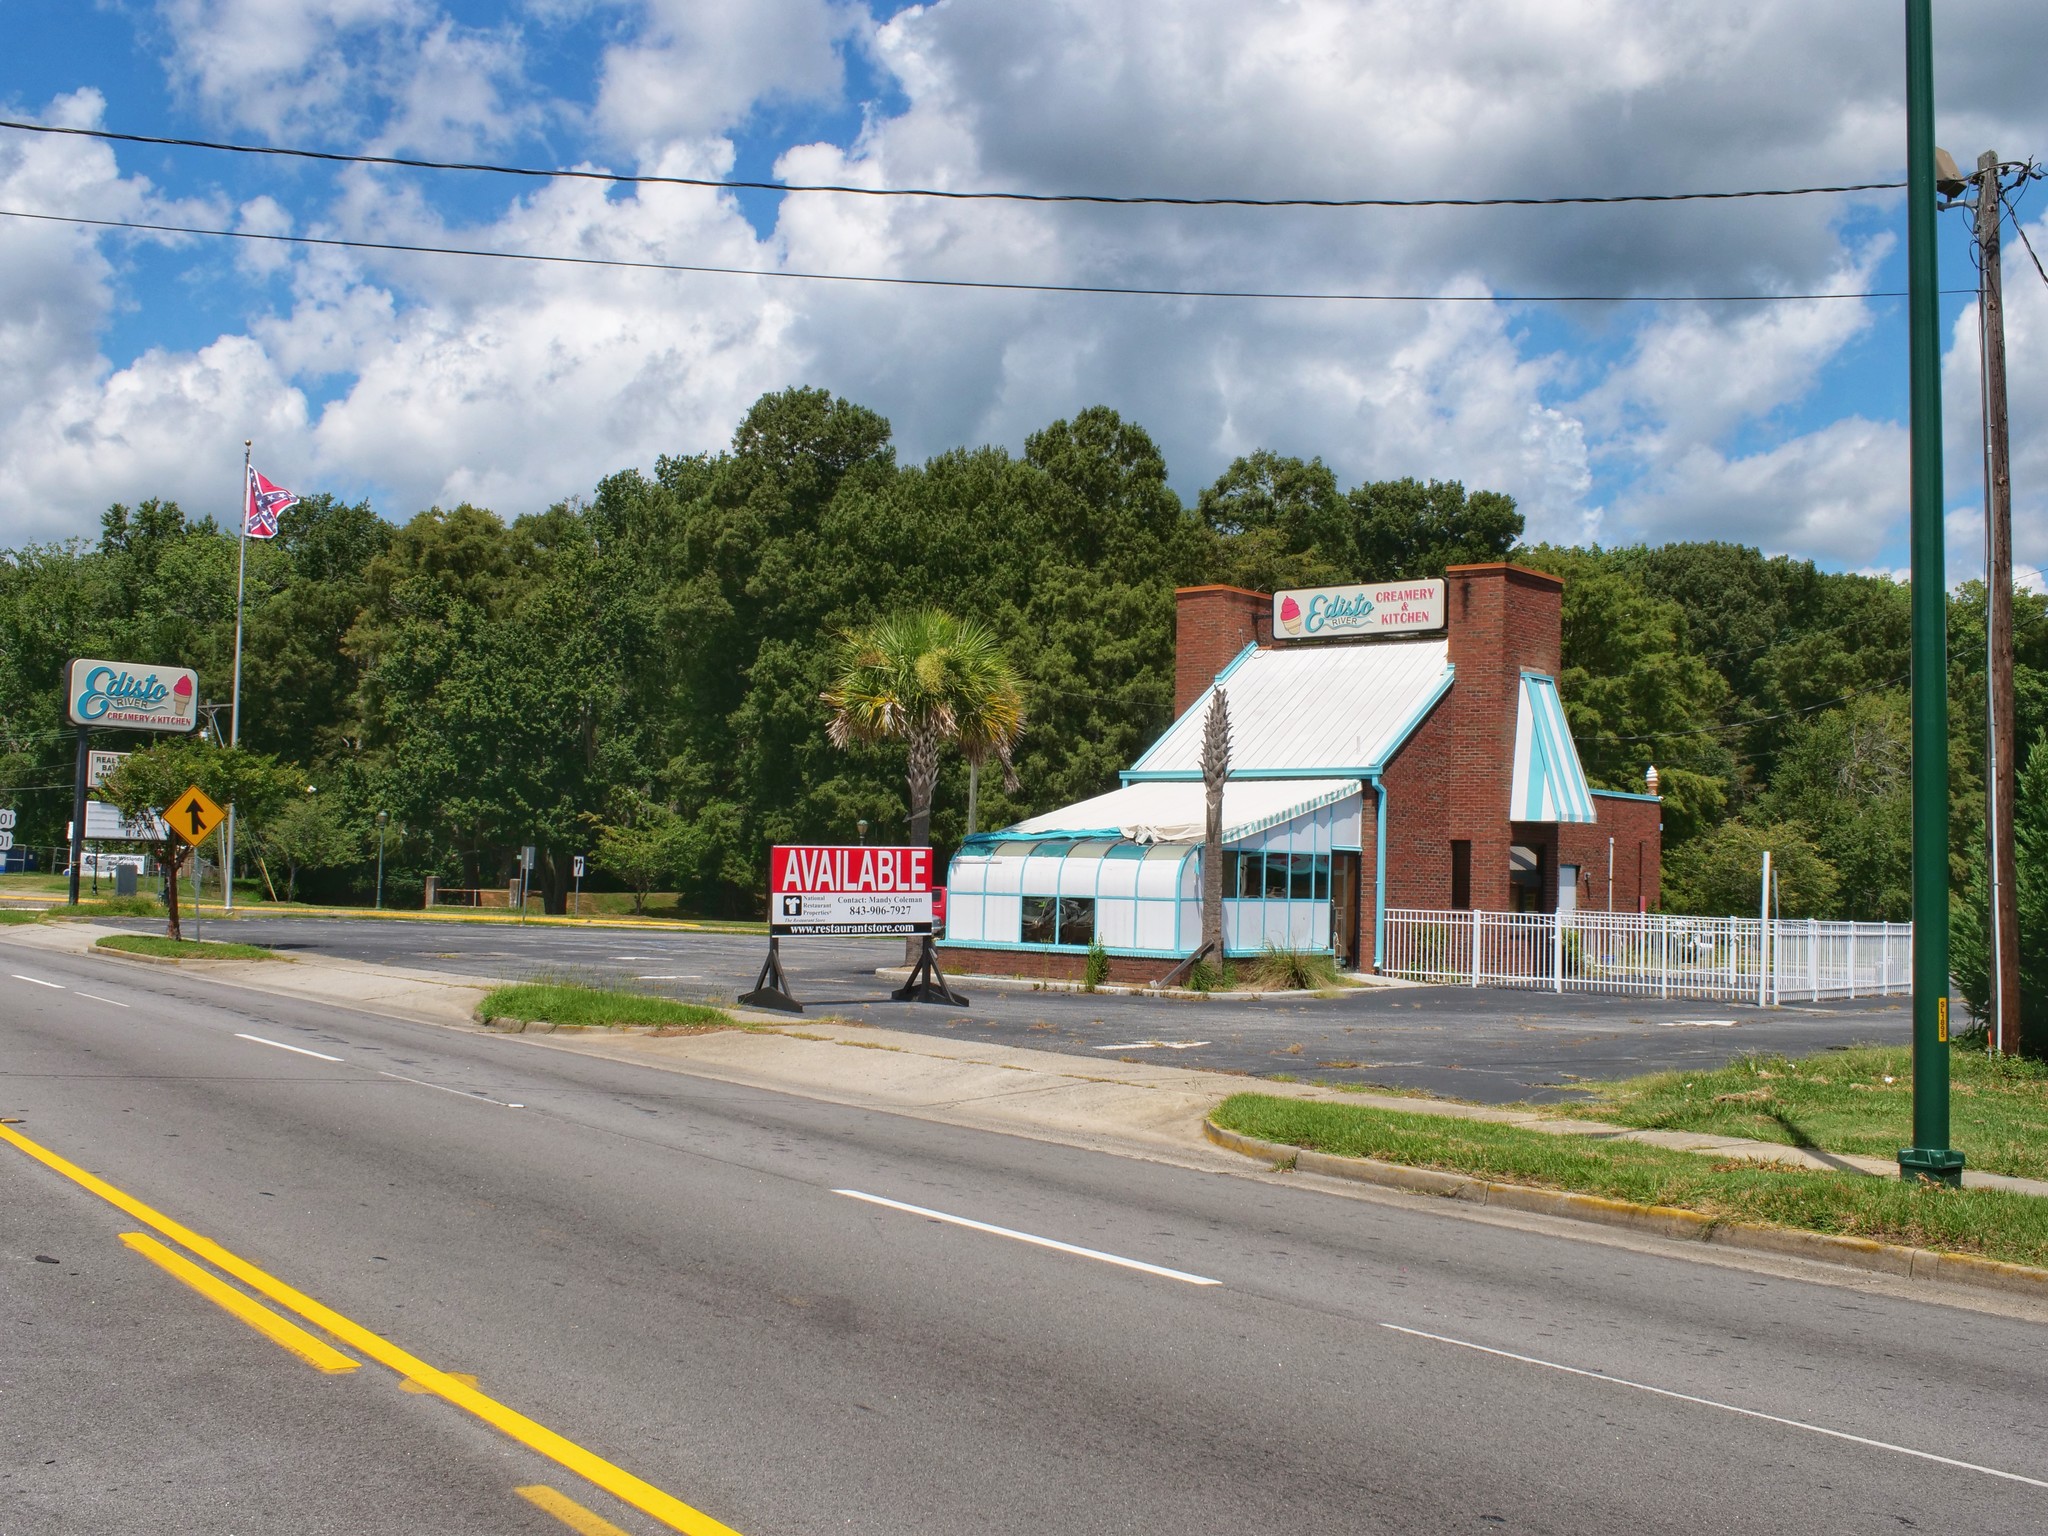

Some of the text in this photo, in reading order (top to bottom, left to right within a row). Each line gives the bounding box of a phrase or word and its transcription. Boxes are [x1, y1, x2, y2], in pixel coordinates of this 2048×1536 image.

[1376, 588, 1435, 603] CREAMERY
[1401, 602, 1409, 611] &
[1305, 592, 1375, 633] Edisto
[1381, 611, 1430, 625] KITCHEN
[1331, 617, 1358, 626] RIVER
[77, 666, 169, 720] Edisto
[116, 698, 148, 709] RIVER
[107, 712, 150, 722] CREAMERY
[157, 715, 191, 726] KITCHEN
[96, 756, 116, 764] REAL
[782, 849, 926, 891] AVAILABLE
[837, 895, 923, 905] Contact: Mandy Coleman
[850, 905, 911, 915] 843-906-7927
[790, 923, 915, 934] www.restaurantstore.com
